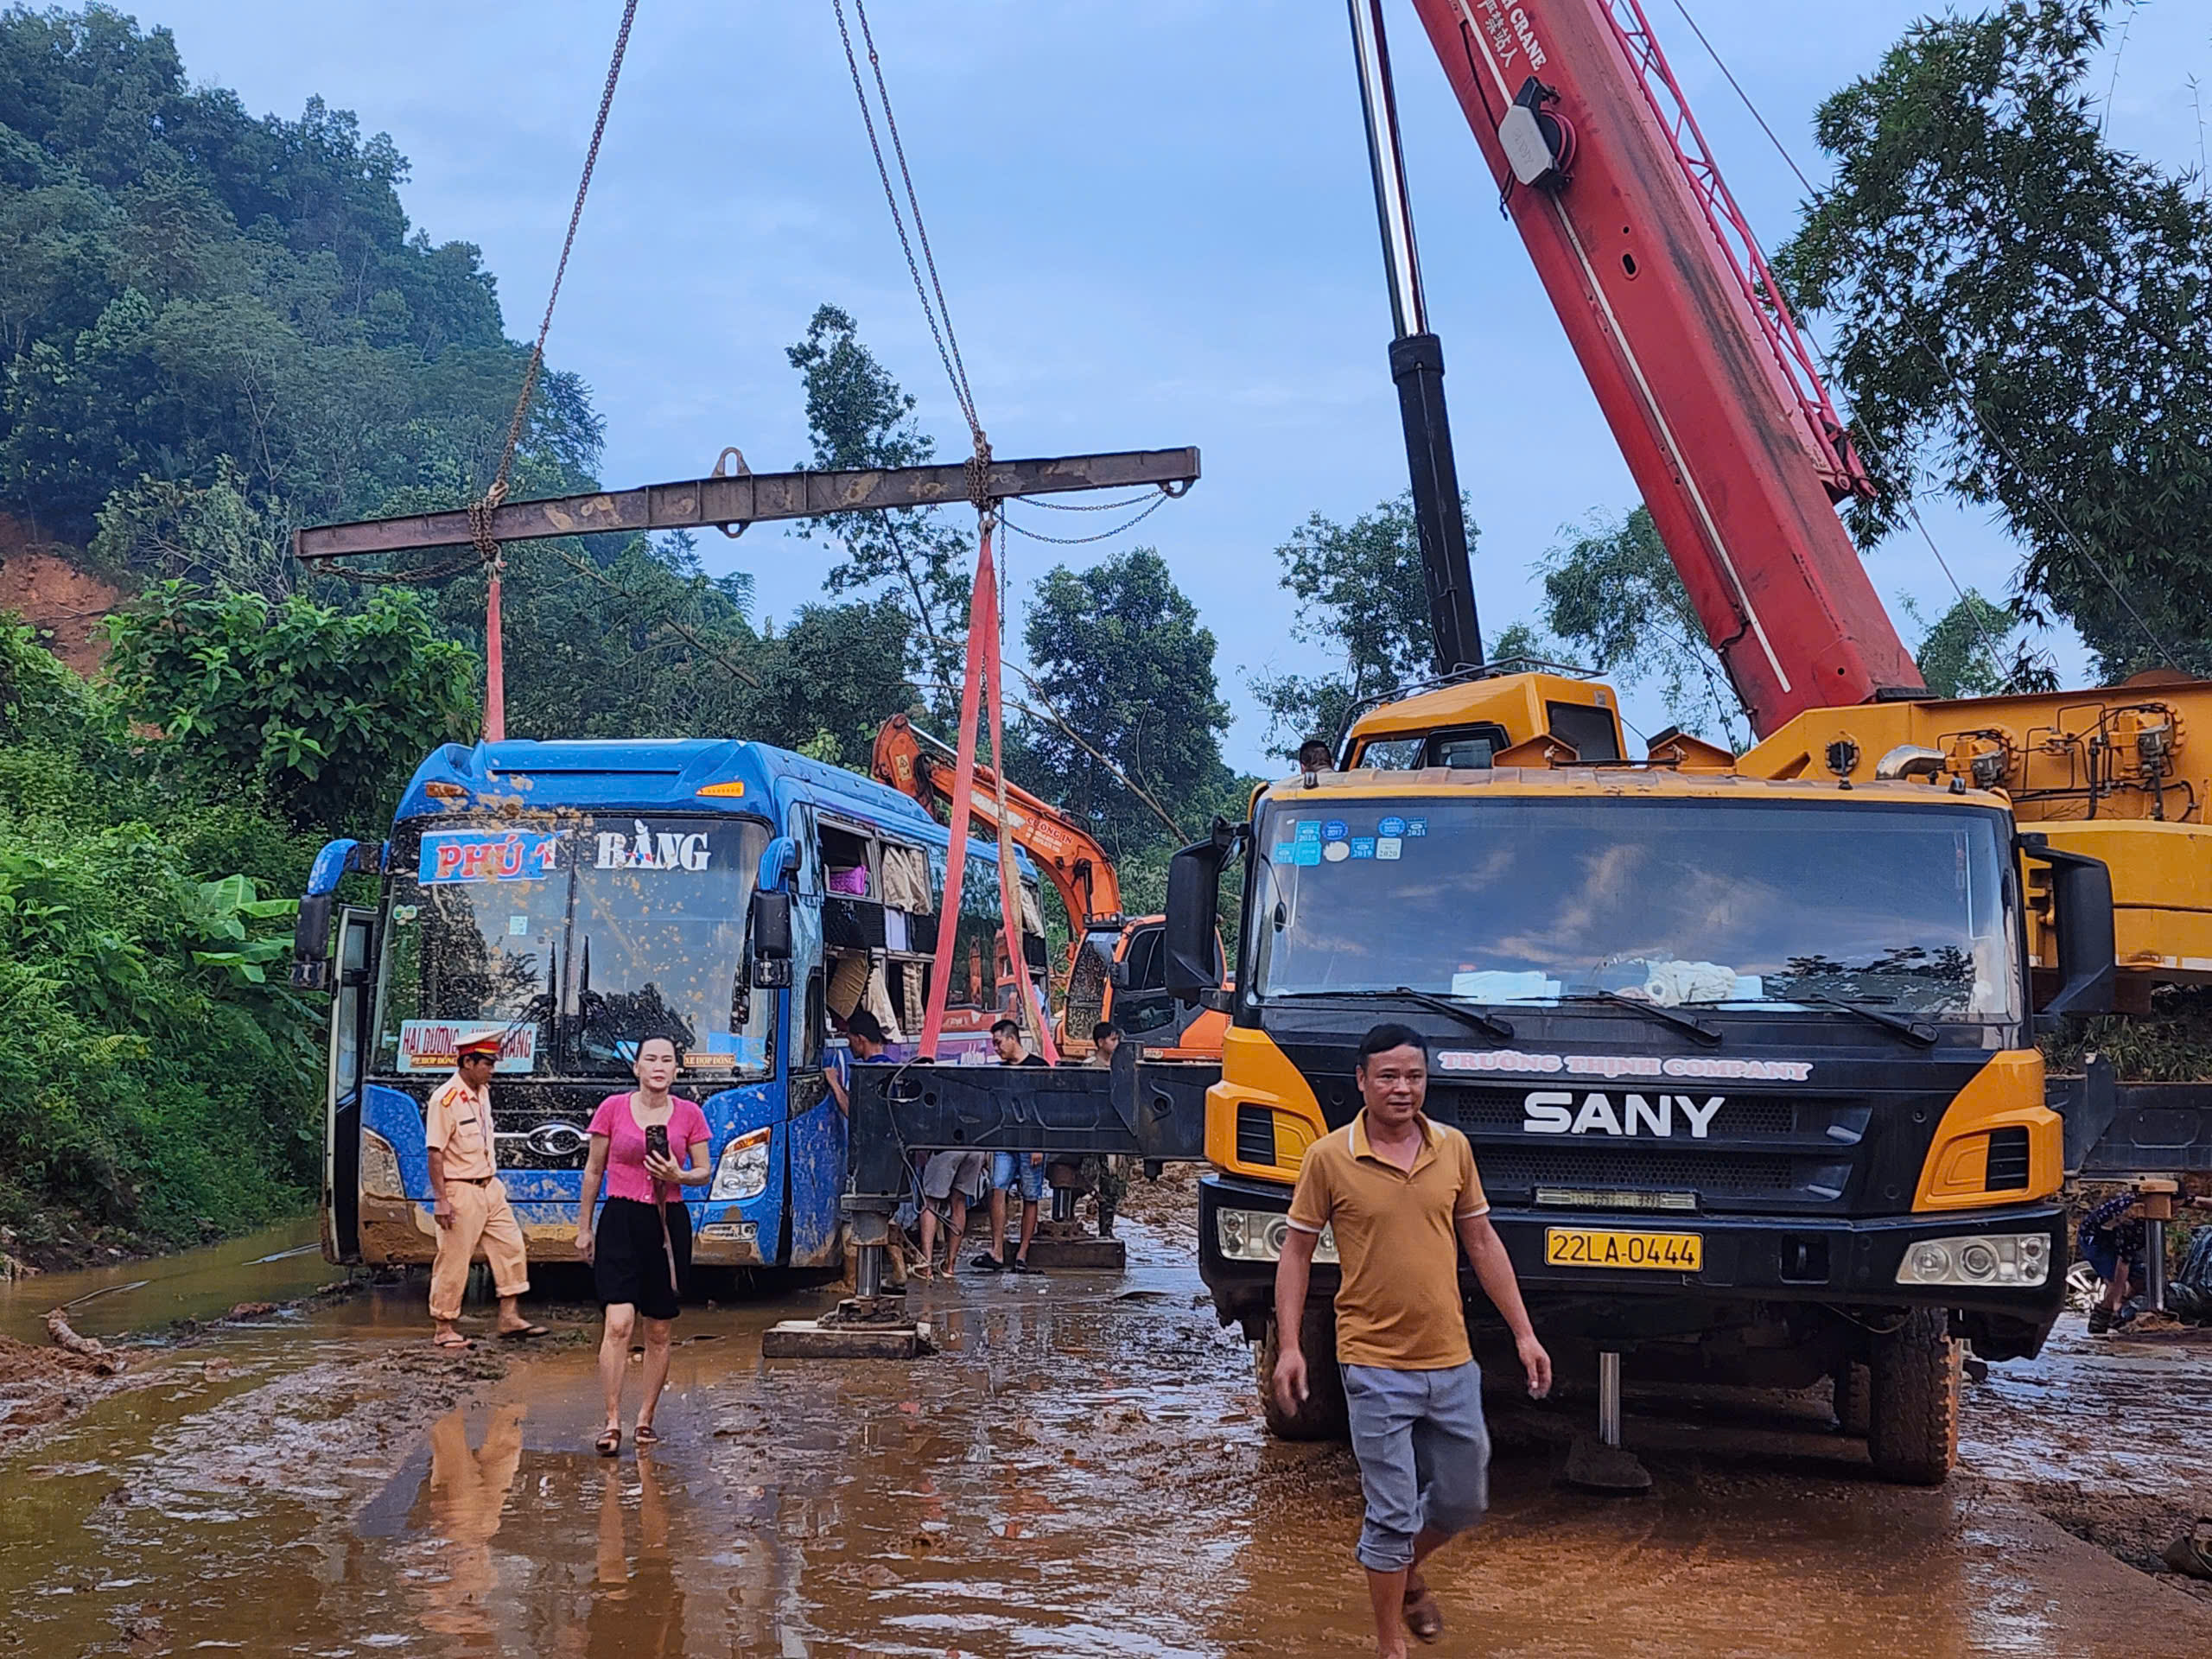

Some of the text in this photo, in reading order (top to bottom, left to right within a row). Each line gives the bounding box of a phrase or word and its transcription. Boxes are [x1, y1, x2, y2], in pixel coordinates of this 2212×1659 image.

[1510, 8, 1547, 71] CRANE
[435, 835, 523, 878] PHÚ
[1663, 1058, 1813, 1080] COMPANY
[1524, 1092, 1726, 1138] SANY
[1553, 1235, 1695, 1266] 22LA-0444
